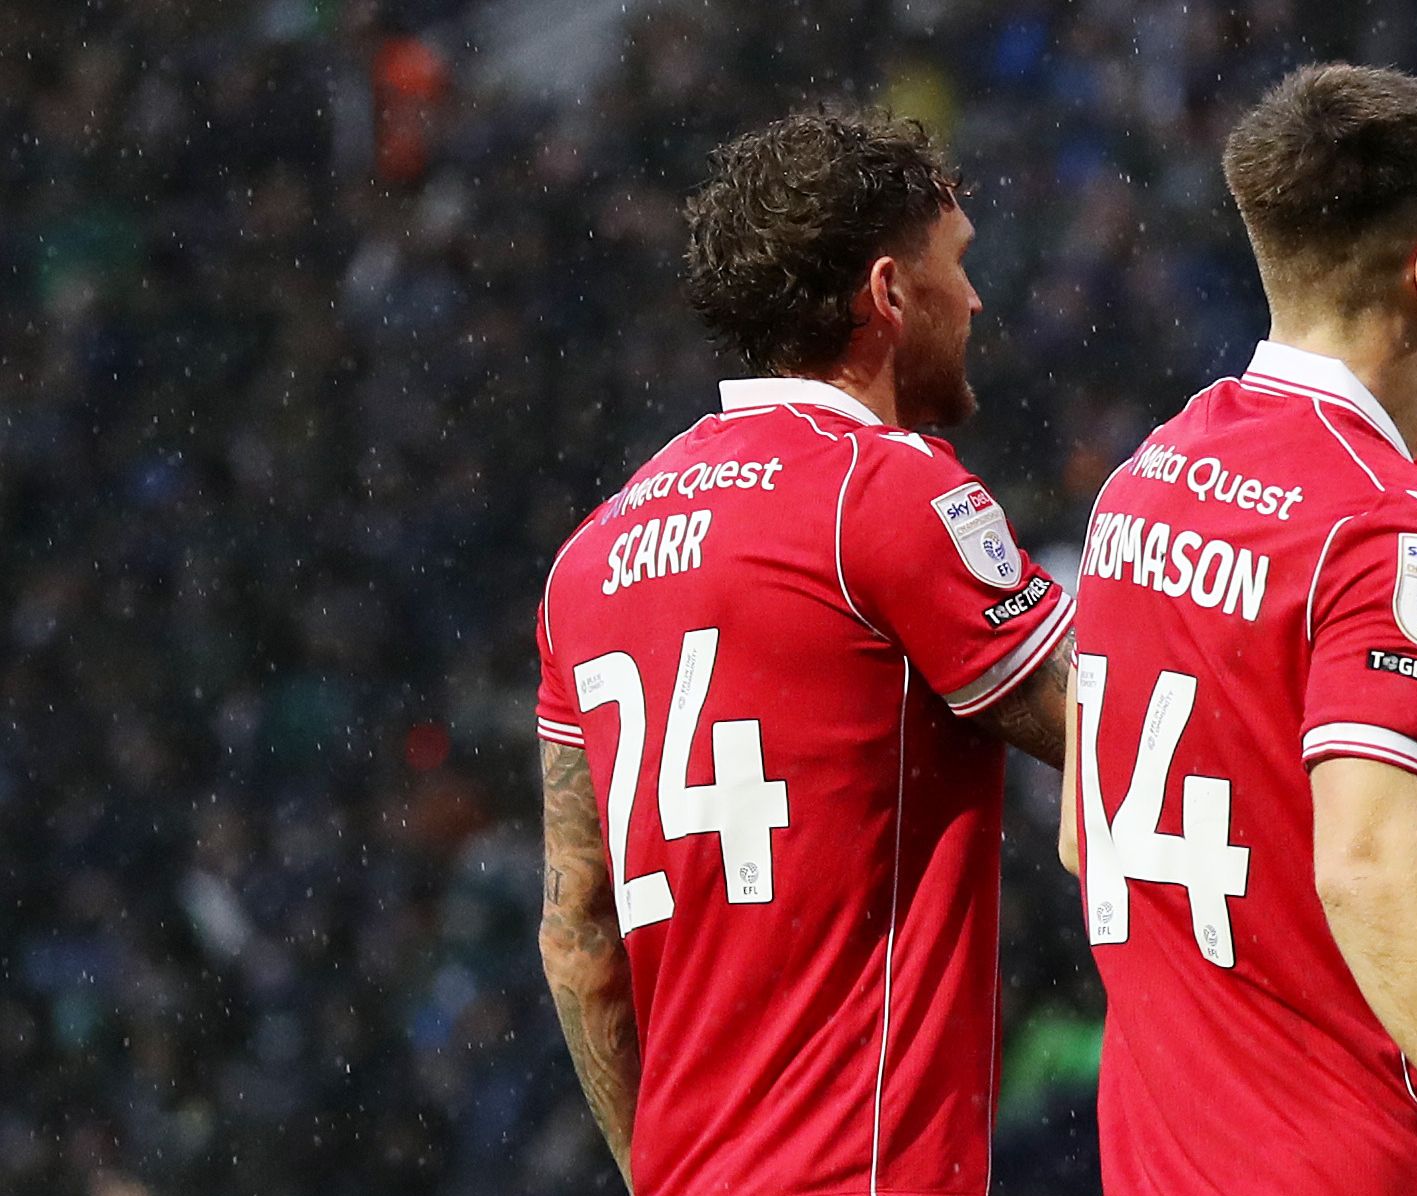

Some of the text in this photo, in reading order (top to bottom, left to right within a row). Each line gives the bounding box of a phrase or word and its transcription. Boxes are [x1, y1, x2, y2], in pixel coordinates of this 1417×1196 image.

[621, 457, 783, 516] Meta Quest
[947, 491, 990, 520] sky bet
[1132, 444, 1304, 520] Meta Quest
[602, 509, 712, 595] SCARR
[998, 562, 1013, 577] EFL
[573, 628, 789, 939] 24
[1077, 653, 1250, 968] 14
[743, 886, 758, 895] EFL
[1098, 927, 1111, 935] EFL
